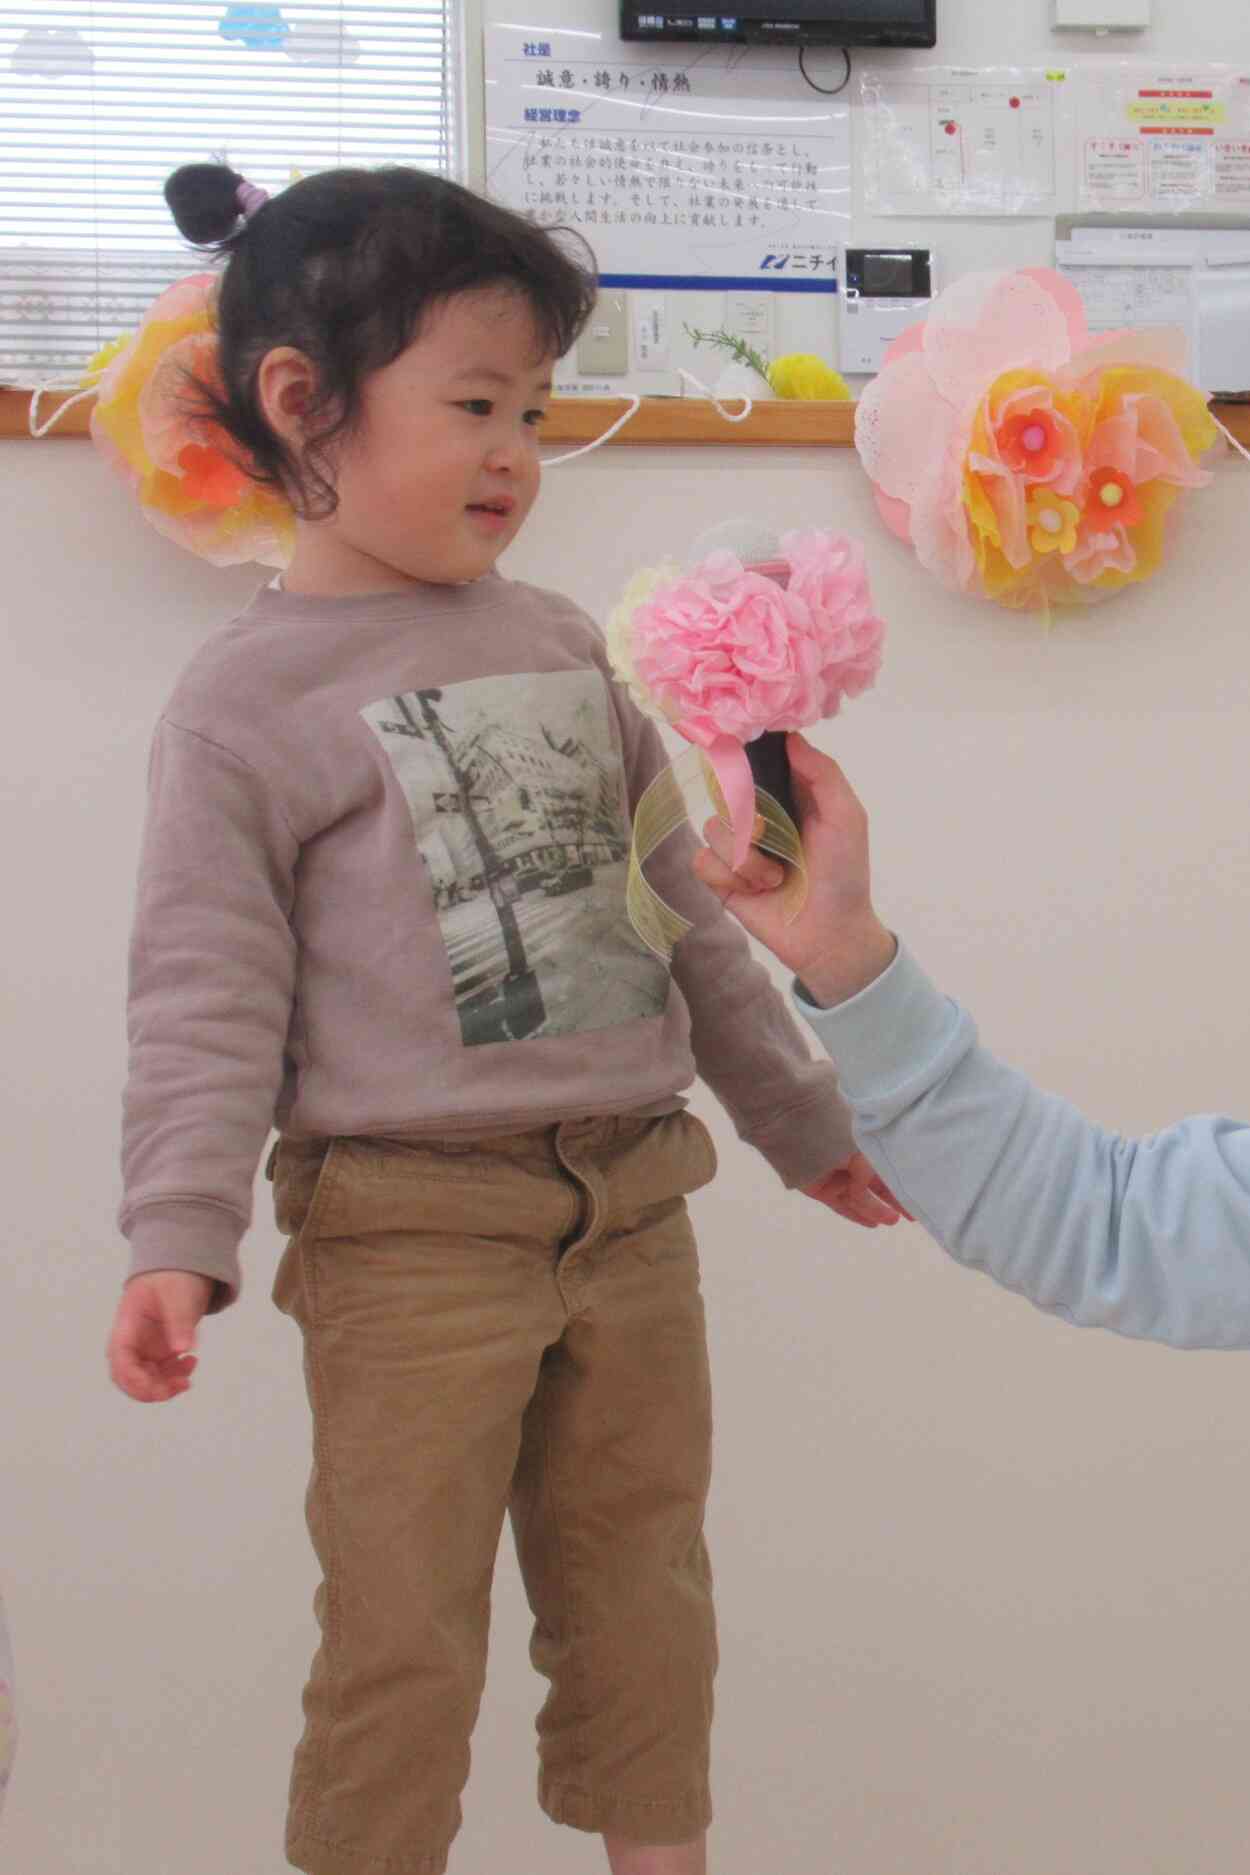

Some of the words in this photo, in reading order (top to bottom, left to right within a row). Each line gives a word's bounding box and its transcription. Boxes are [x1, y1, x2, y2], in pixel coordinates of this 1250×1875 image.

[536, 69, 691, 92] 誠意・誇り・情熱
[524, 108, 581, 123] 経営理念
[791, 254, 839, 272] ニチイ
